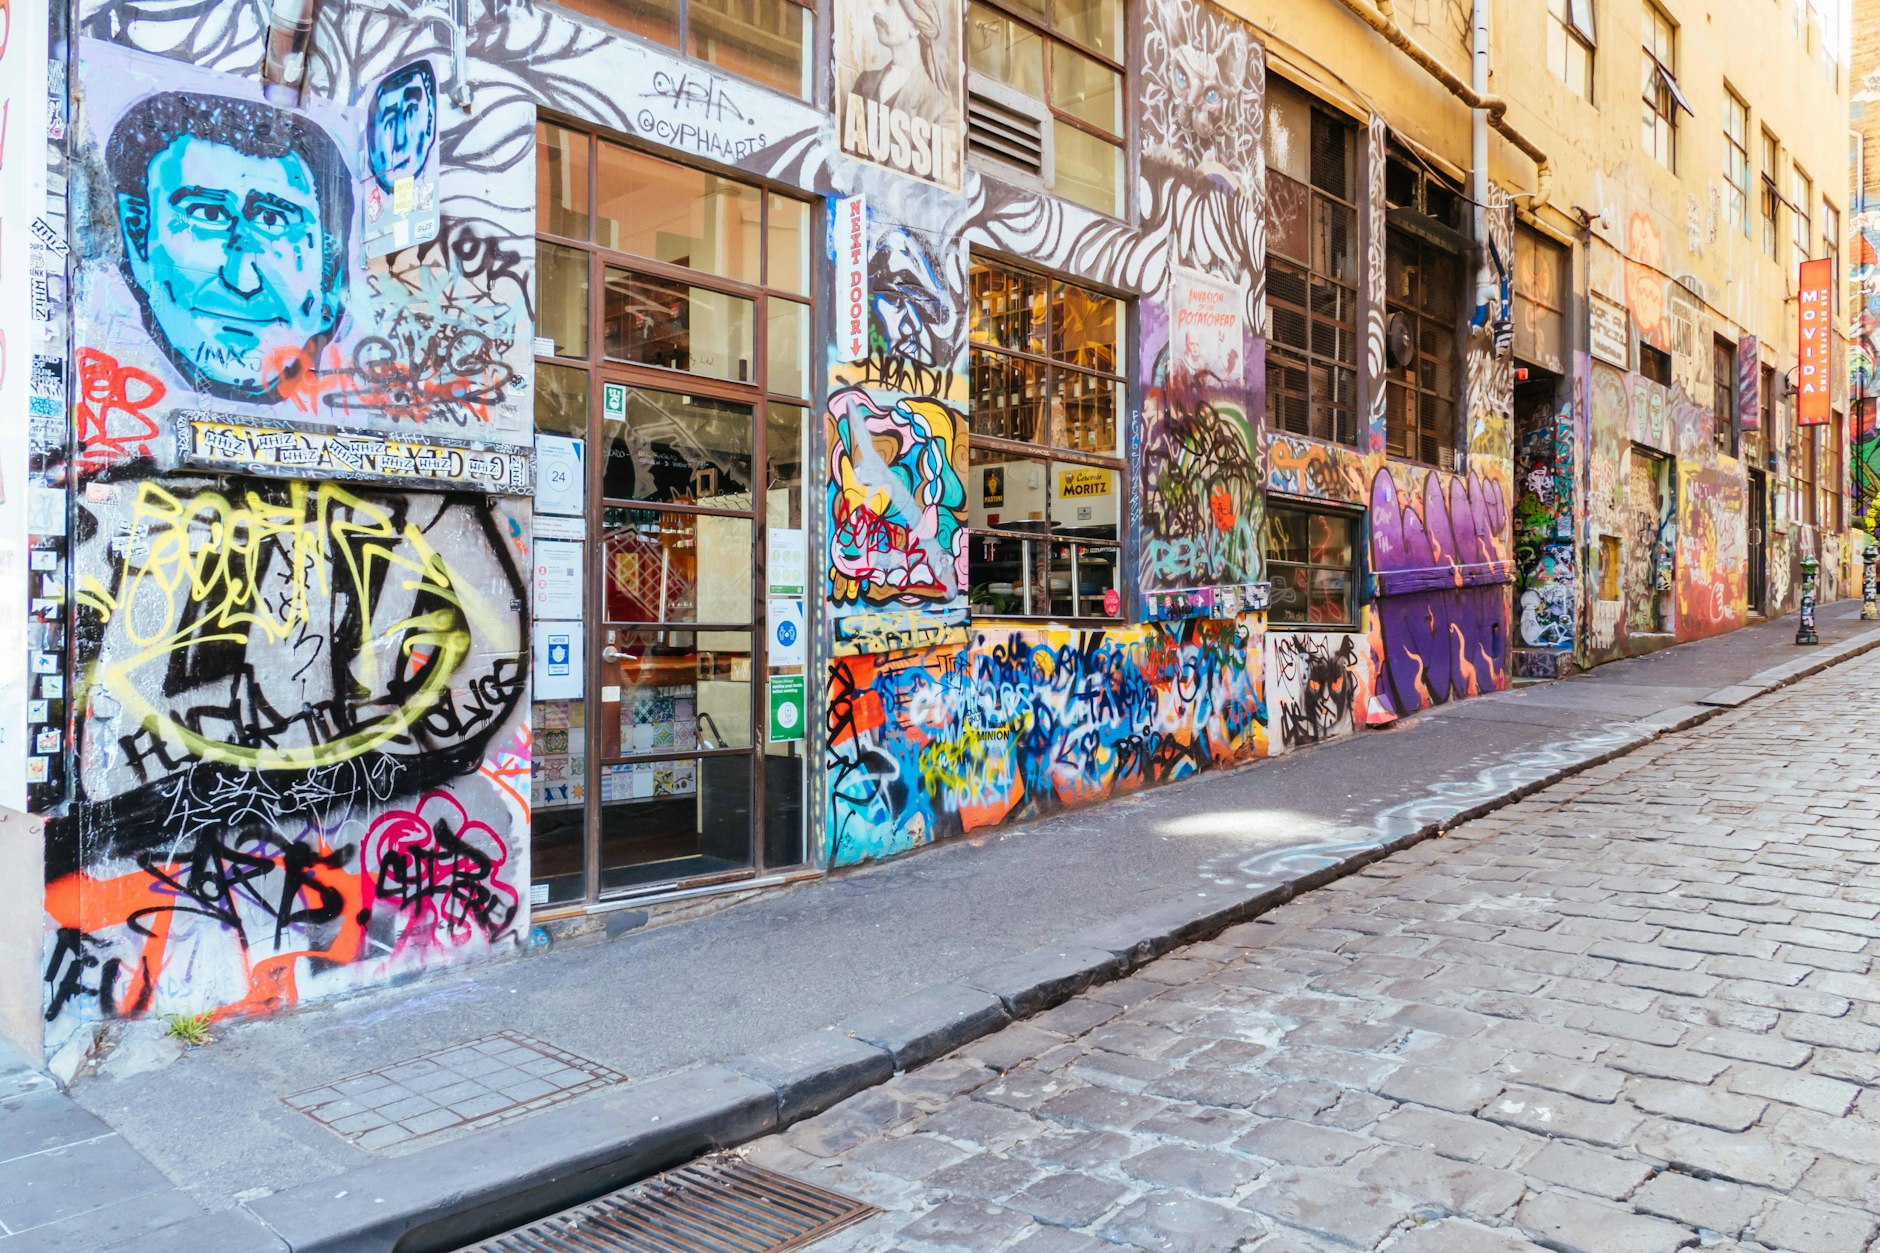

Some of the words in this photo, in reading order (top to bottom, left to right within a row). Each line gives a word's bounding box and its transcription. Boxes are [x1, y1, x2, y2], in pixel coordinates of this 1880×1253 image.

[844, 91, 960, 187] AUSSIE
[850, 200, 861, 265] NEXT
[850, 271, 862, 335] DOOR
[1802, 290, 1818, 393] MOVIDA
[552, 471, 566, 483] 24
[1063, 482, 1106, 496] MORITZ
